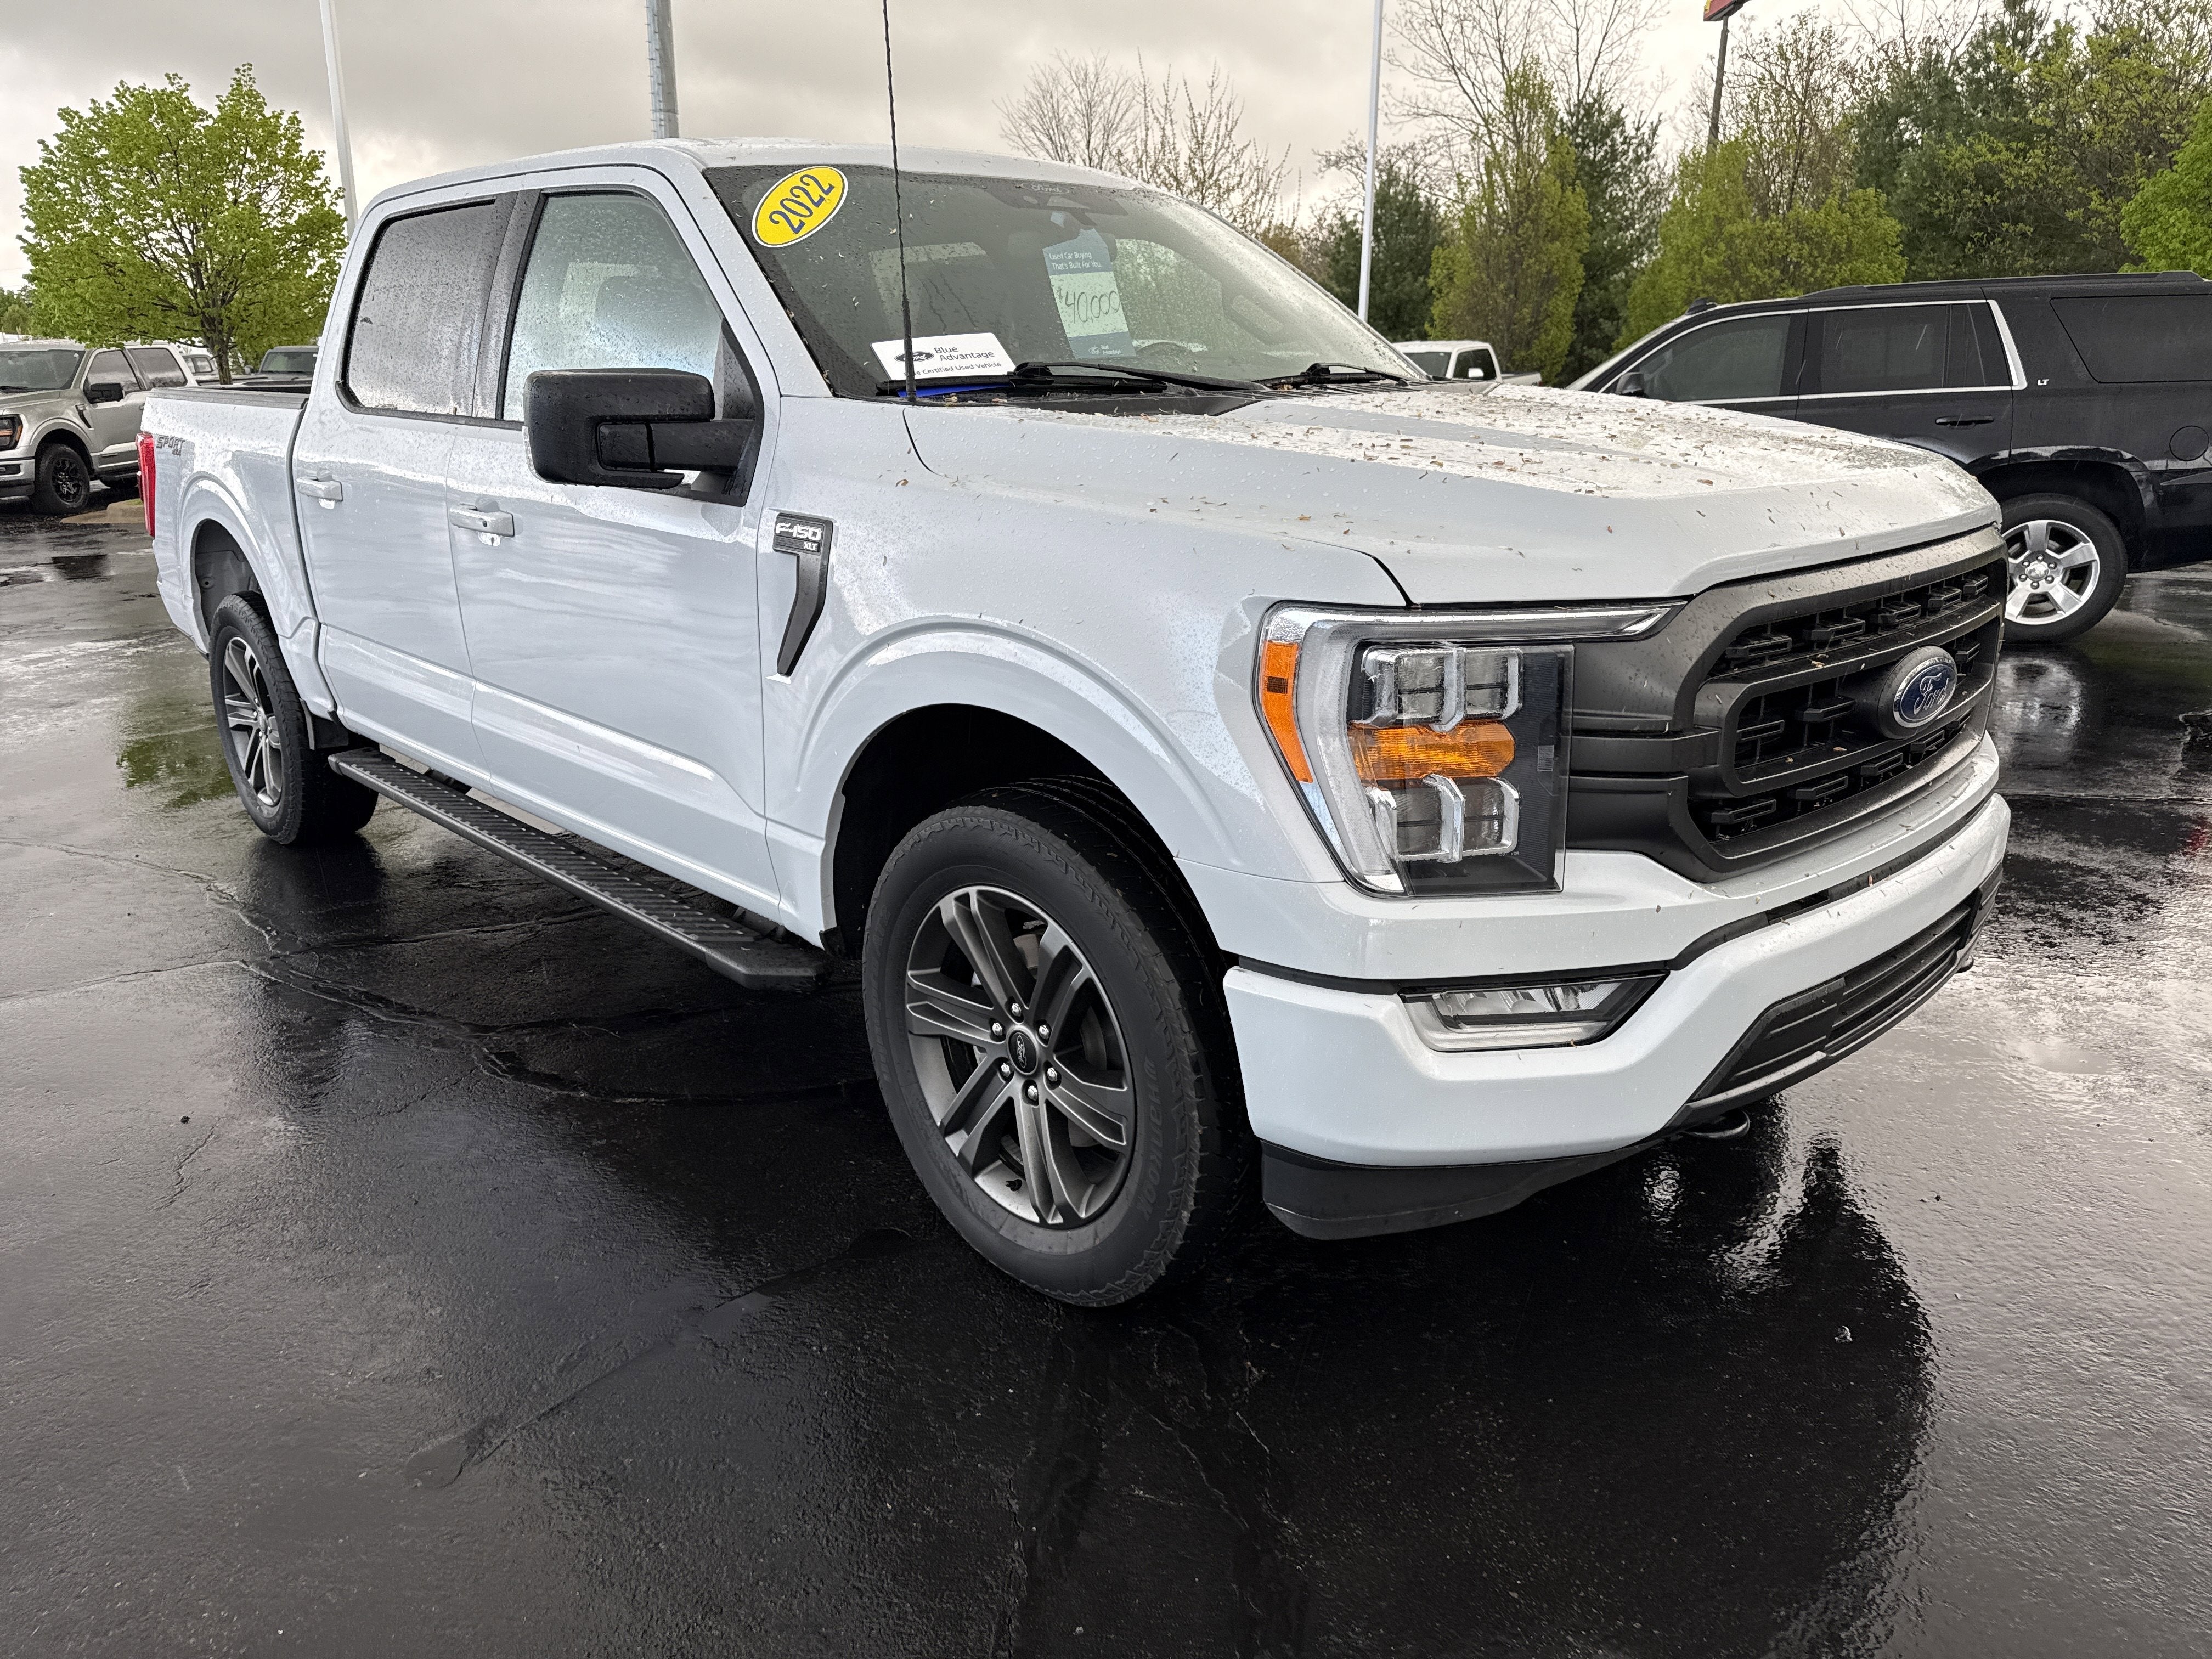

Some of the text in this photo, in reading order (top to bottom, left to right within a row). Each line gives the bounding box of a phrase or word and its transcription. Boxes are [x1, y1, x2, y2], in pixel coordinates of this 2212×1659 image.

[769, 174, 835, 235] 2022
[1074, 251, 1092, 259] Buying
[1056, 286, 1120, 324] $40,000
[940, 352, 995, 361] Advantage
[156, 435, 185, 449] SPORT
[775, 522, 822, 541] F-150
[803, 541, 818, 551] XLT
[1913, 673, 1950, 714] Ford
